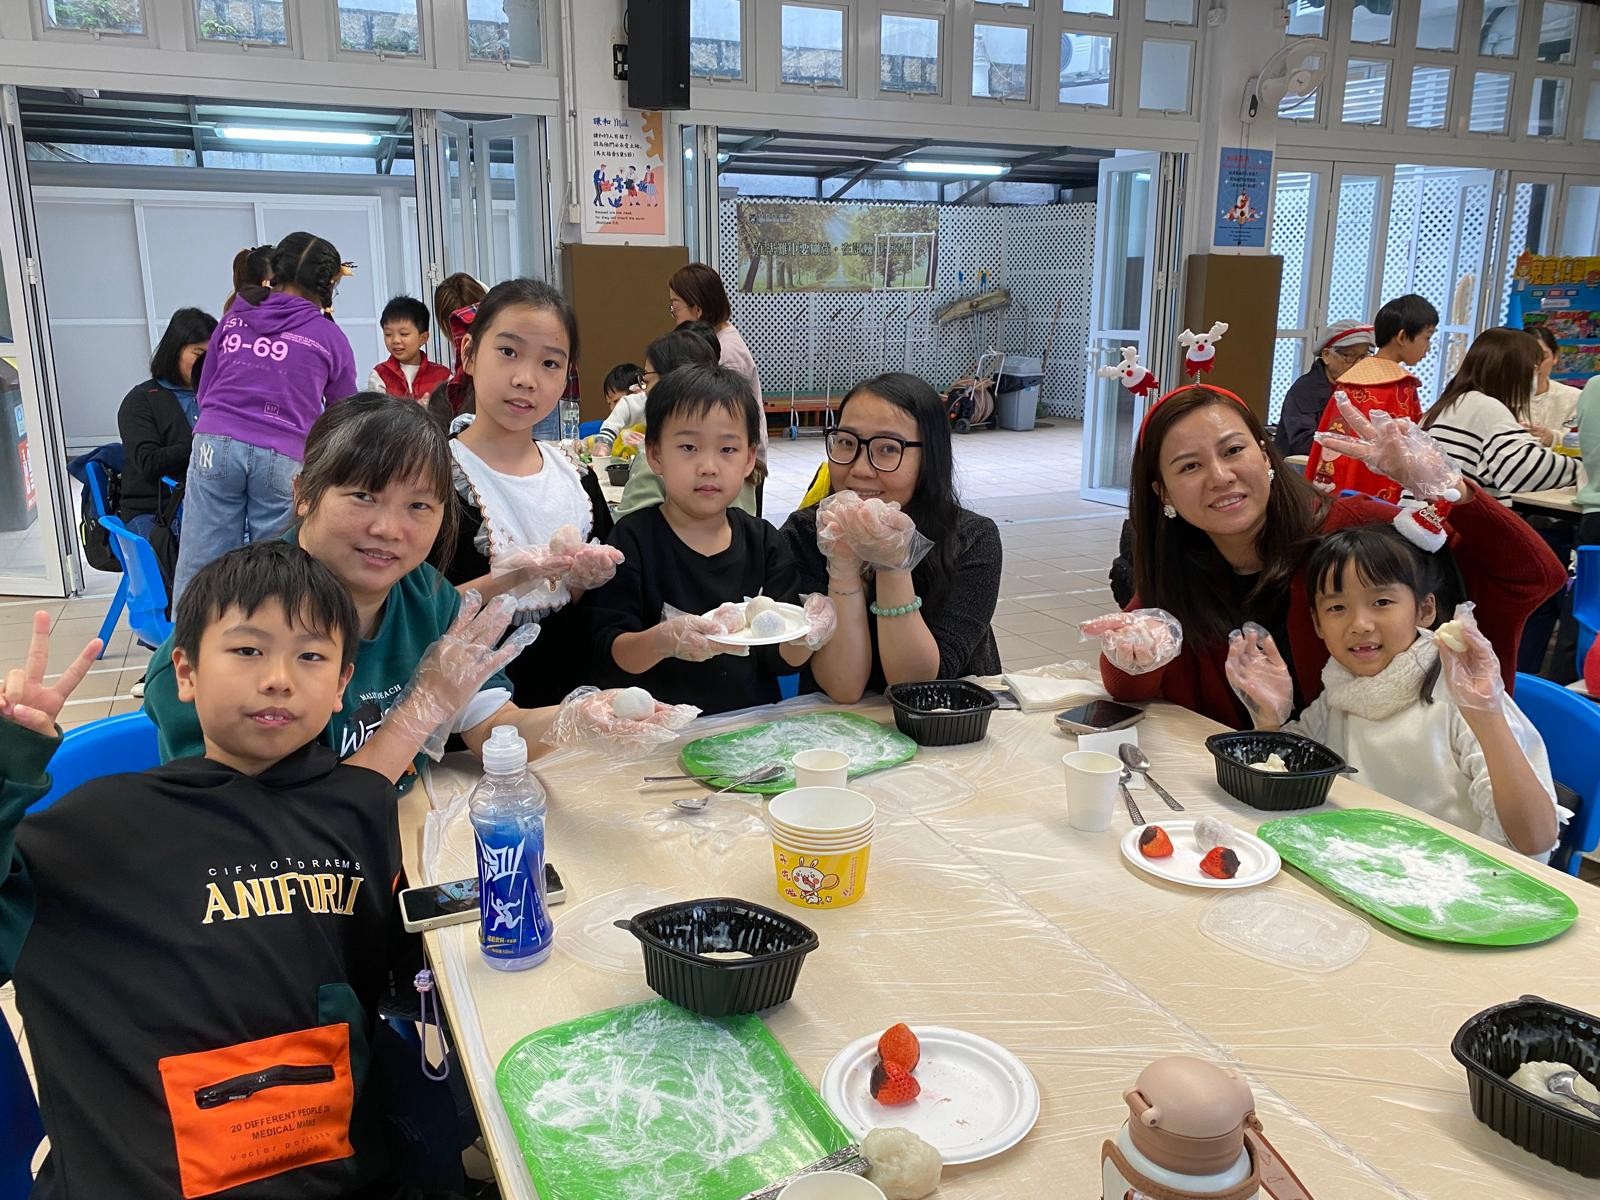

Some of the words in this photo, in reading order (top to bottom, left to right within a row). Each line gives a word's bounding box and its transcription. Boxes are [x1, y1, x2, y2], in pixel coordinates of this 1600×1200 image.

[230, 1124, 242, 1133] 20
[244, 1110, 297, 1130] DIFFERENT
[252, 1123, 295, 1140] MEDICAL
